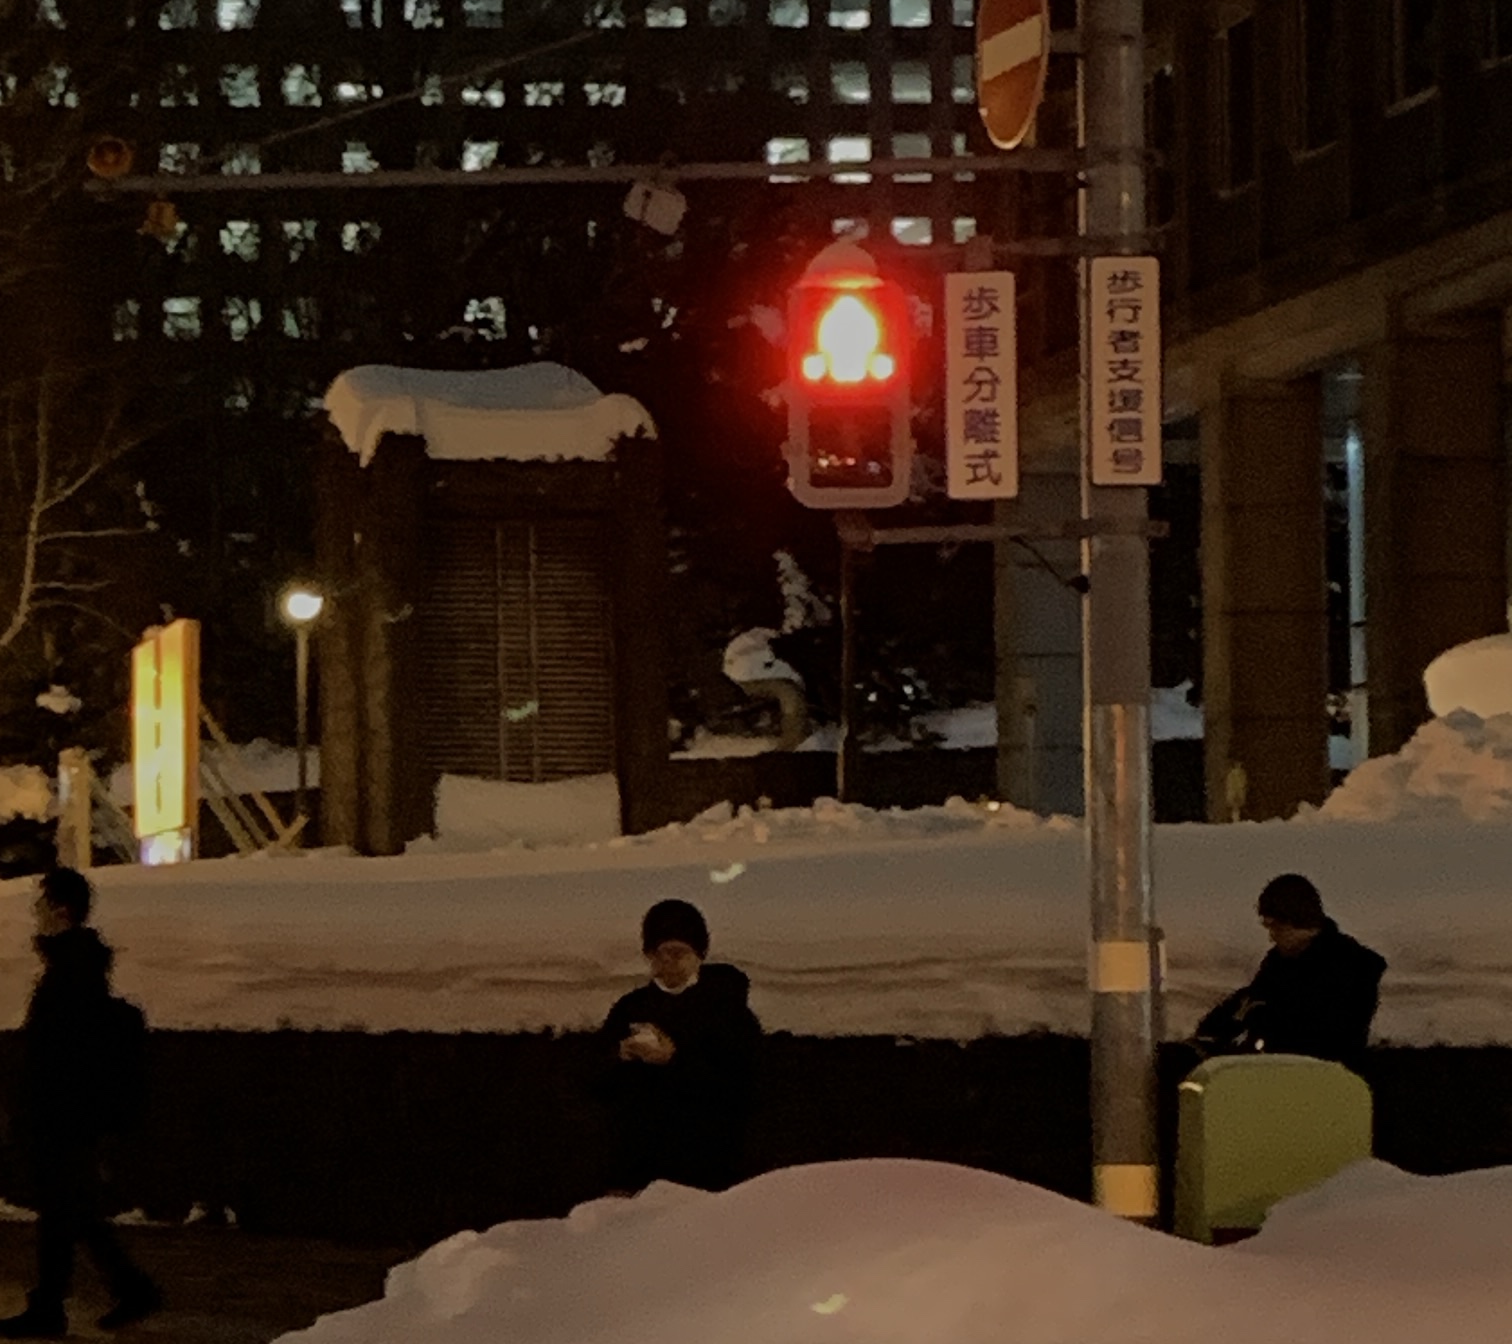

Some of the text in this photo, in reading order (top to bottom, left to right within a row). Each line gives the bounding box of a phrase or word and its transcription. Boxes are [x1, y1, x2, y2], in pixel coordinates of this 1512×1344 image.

[962, 286, 1002, 487] 歩車分離式
